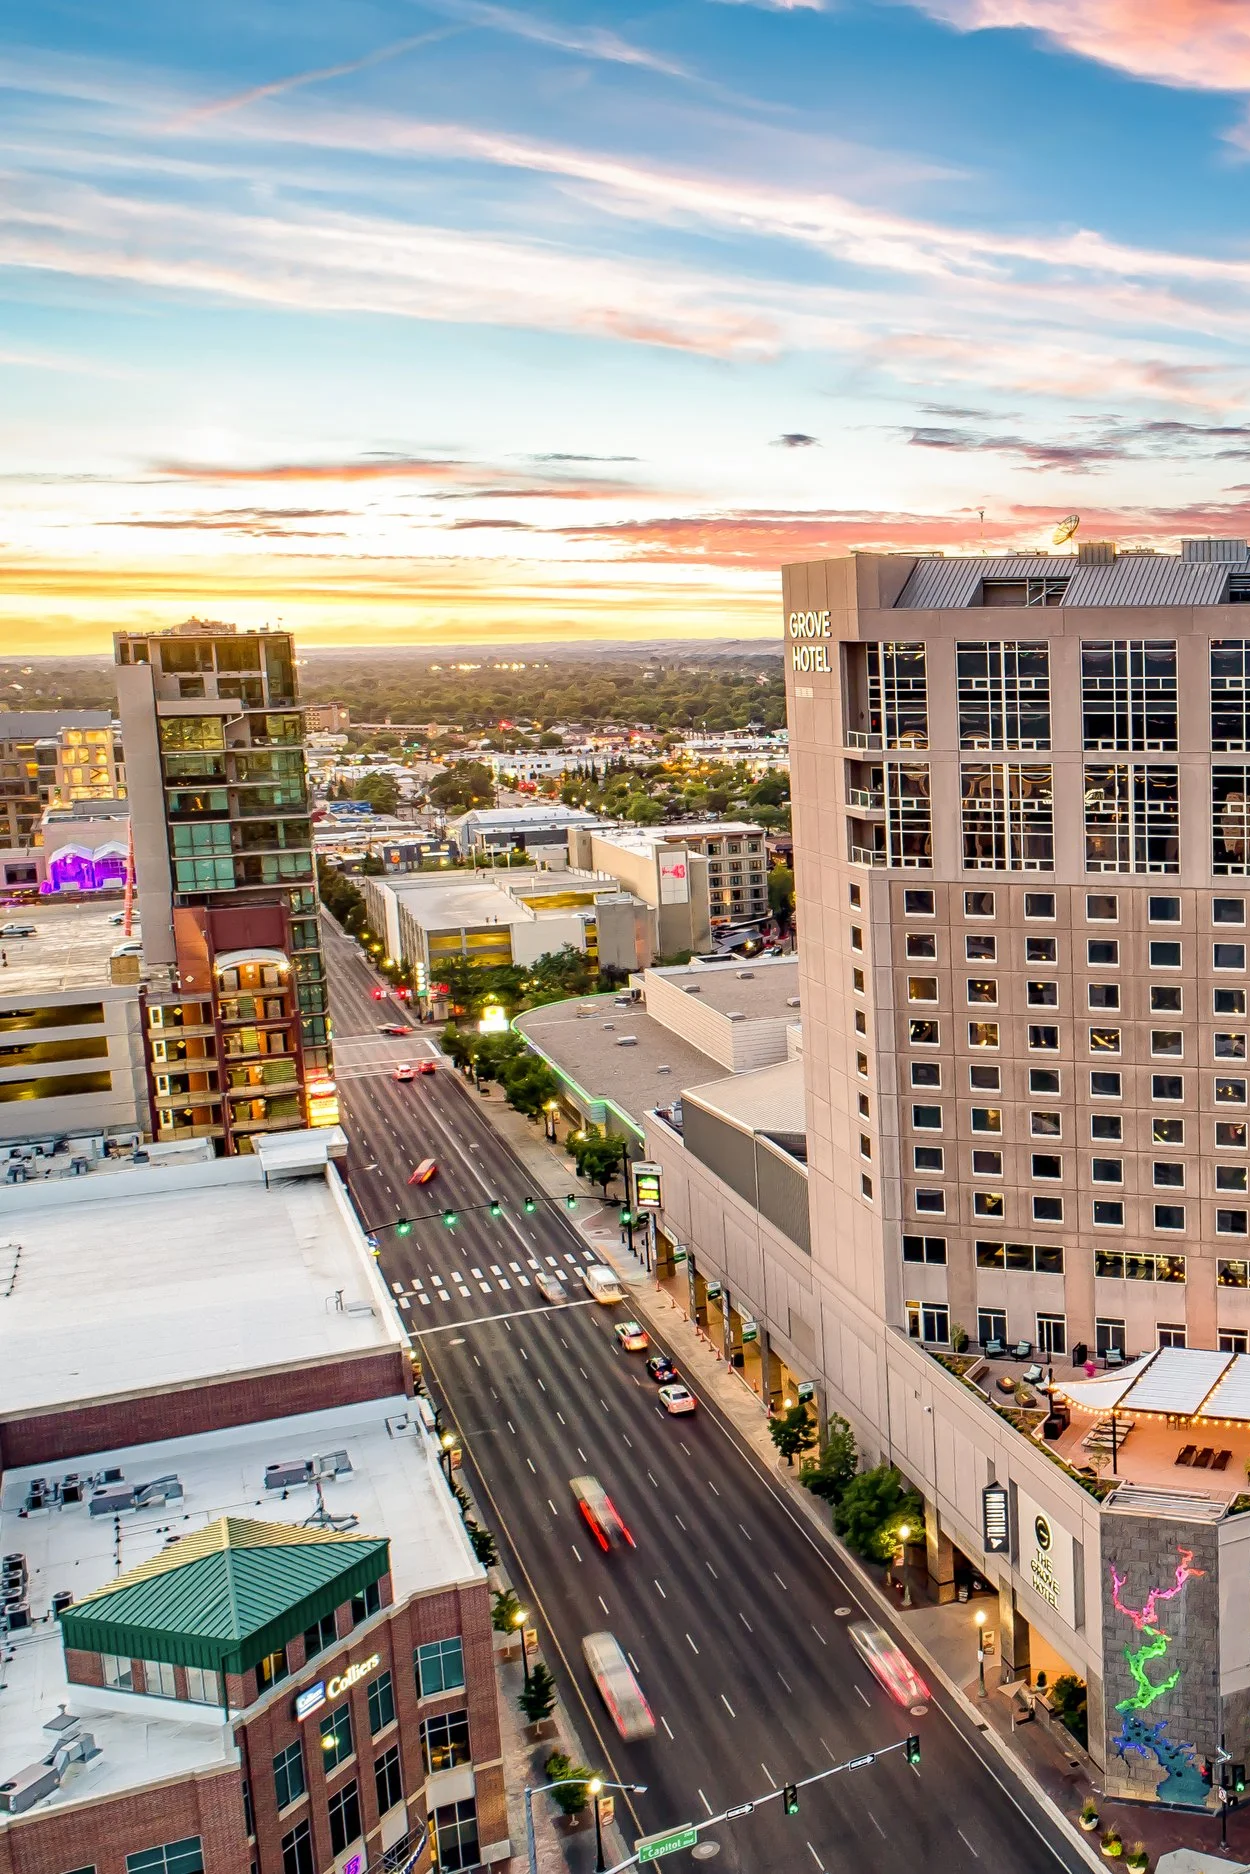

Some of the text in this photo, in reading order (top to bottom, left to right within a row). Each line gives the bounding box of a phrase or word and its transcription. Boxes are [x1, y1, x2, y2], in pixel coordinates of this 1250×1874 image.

[789, 611, 831, 638] GROVE
[792, 646, 831, 672] HOTEL
[1036, 1548, 1053, 1574] THE
[1030, 1559, 1060, 1595] GROVE
[1032, 1575, 1059, 1611] HOTEL
[326, 1653, 381, 1699] Colliers
[648, 1840, 681, 1857] Capitol
